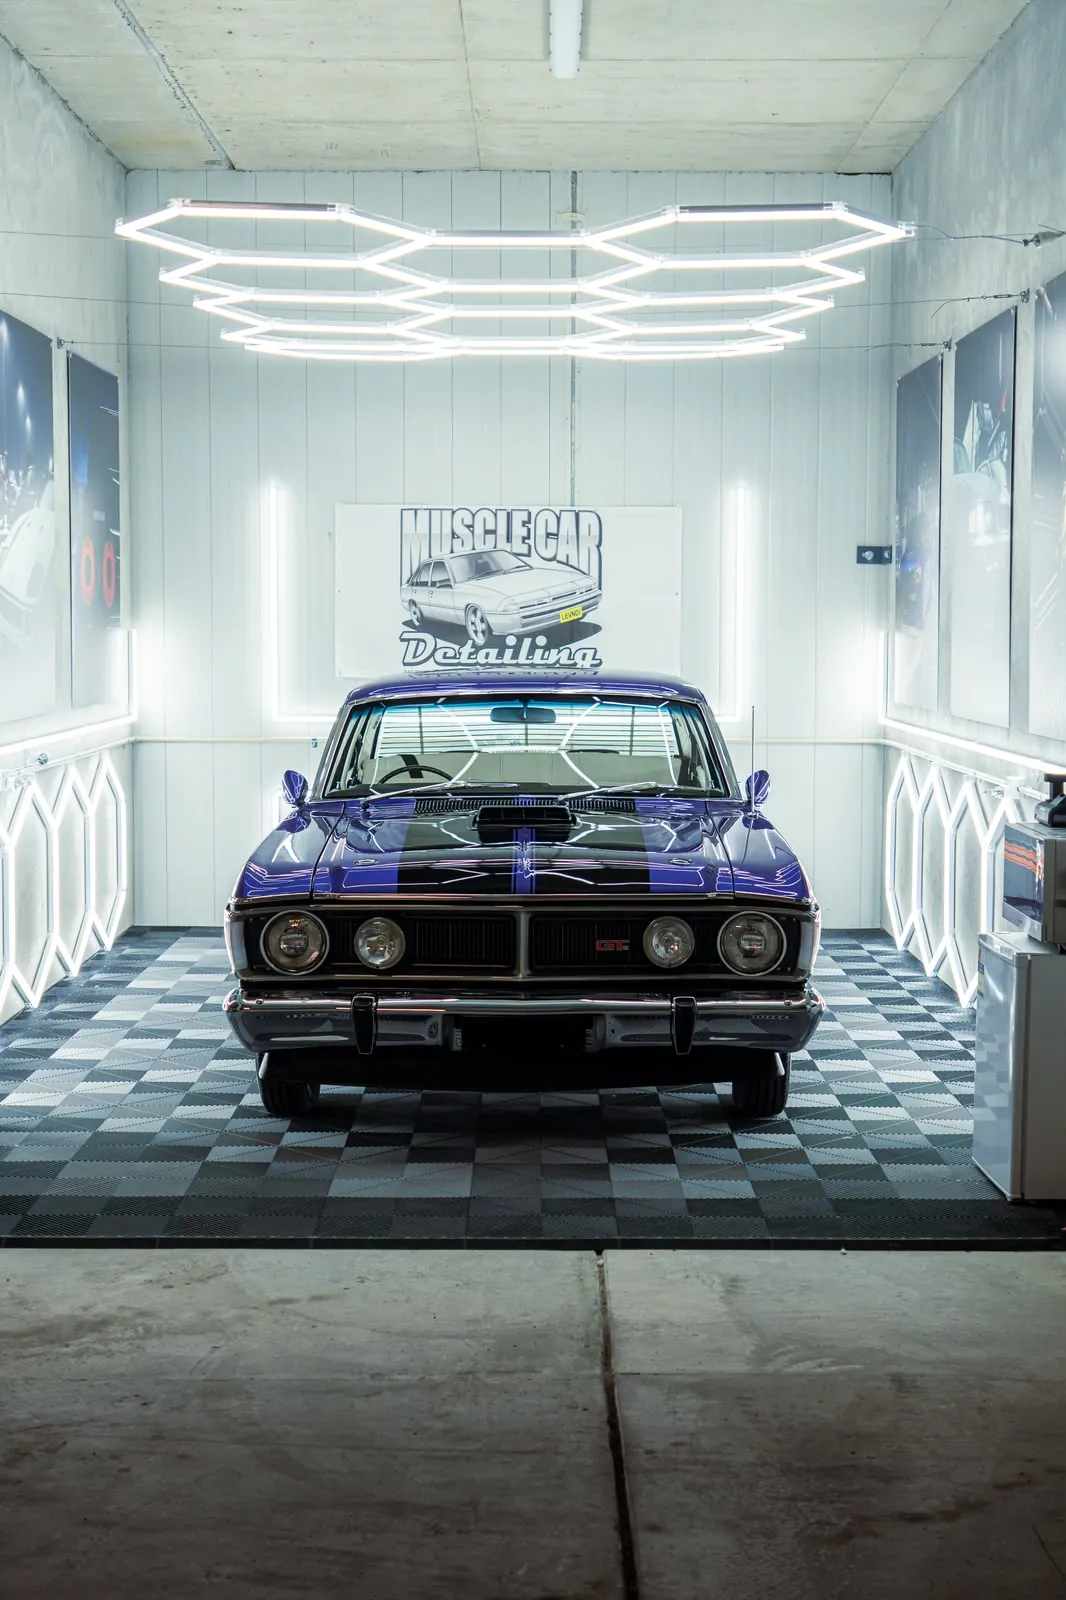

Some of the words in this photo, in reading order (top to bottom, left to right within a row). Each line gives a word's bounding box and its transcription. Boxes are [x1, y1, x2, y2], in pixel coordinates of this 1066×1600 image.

[400, 508, 531, 586] MUSCLE
[534, 508, 602, 590] CAR
[400, 631, 602, 668] Detailing
[596, 940, 629, 951] GT
